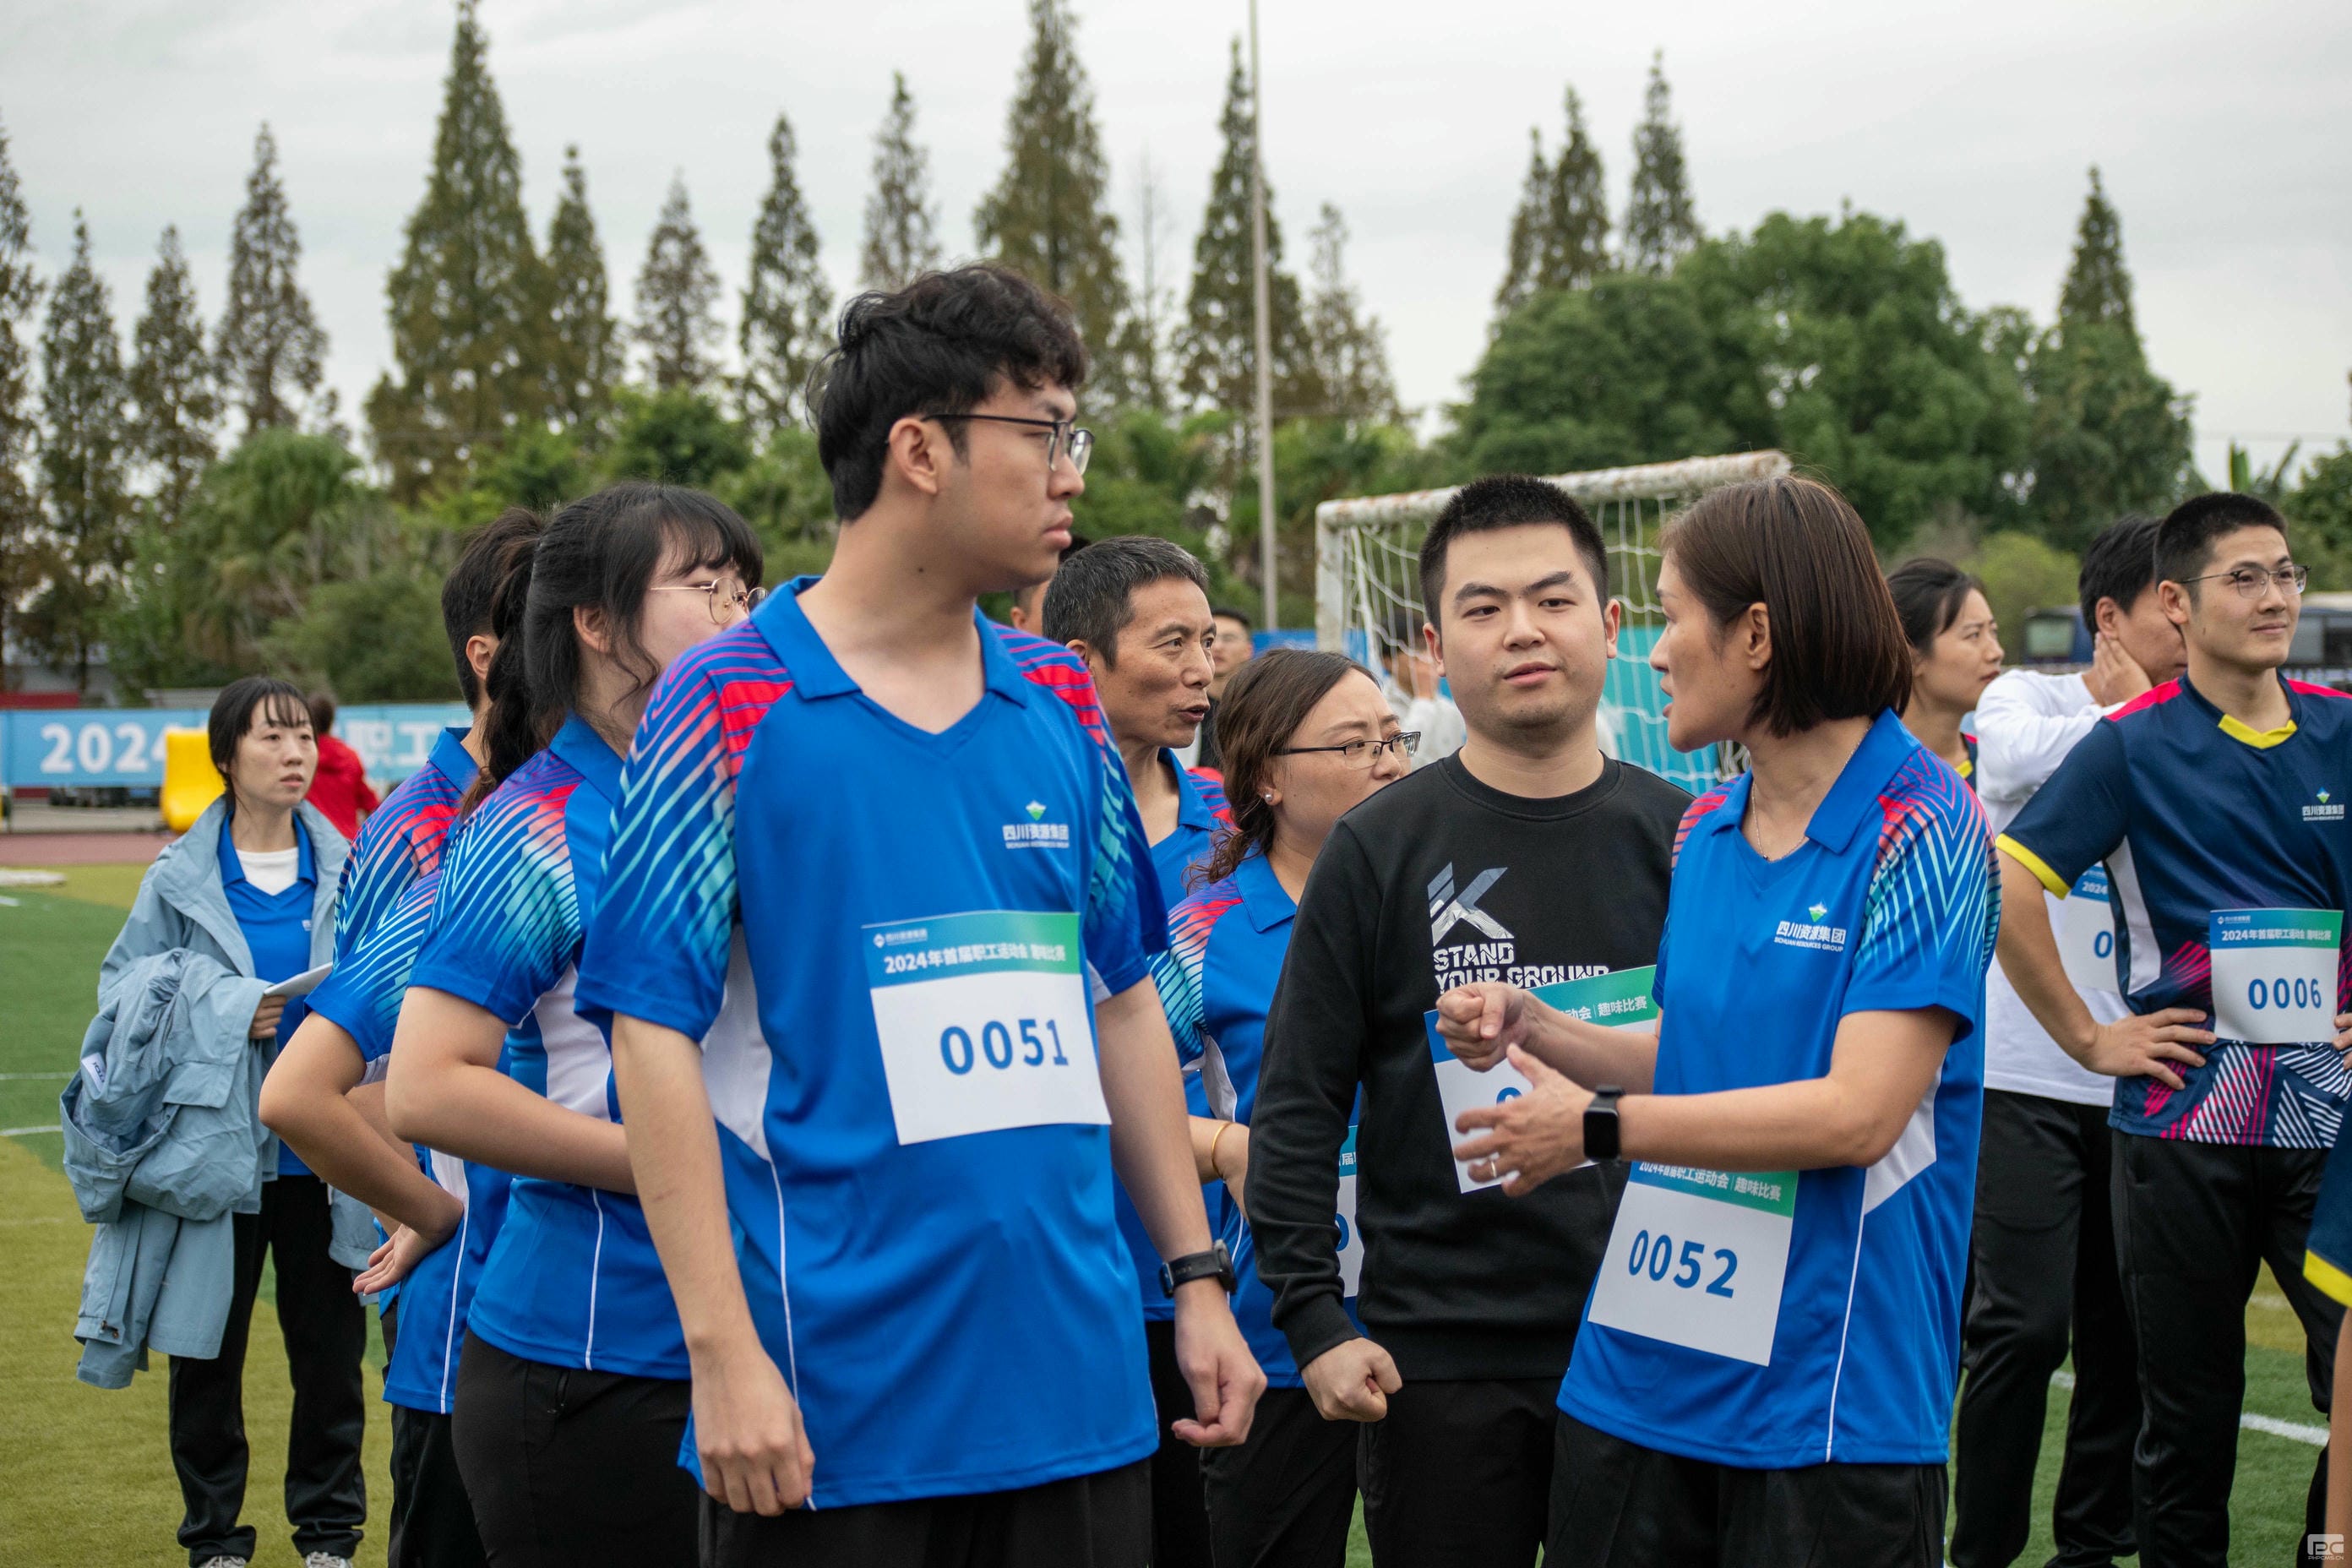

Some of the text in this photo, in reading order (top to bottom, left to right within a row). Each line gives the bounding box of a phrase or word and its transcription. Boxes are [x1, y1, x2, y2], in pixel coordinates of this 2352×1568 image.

[1776, 920, 1846, 945] 四川资源集团
[1433, 942, 1515, 972] STAND
[1598, 995, 1647, 1017] 趣味比赛
[2248, 977, 2322, 1010] 0006
[940, 1018, 1069, 1075] 0051
[1628, 1229, 1739, 1298] 0052
